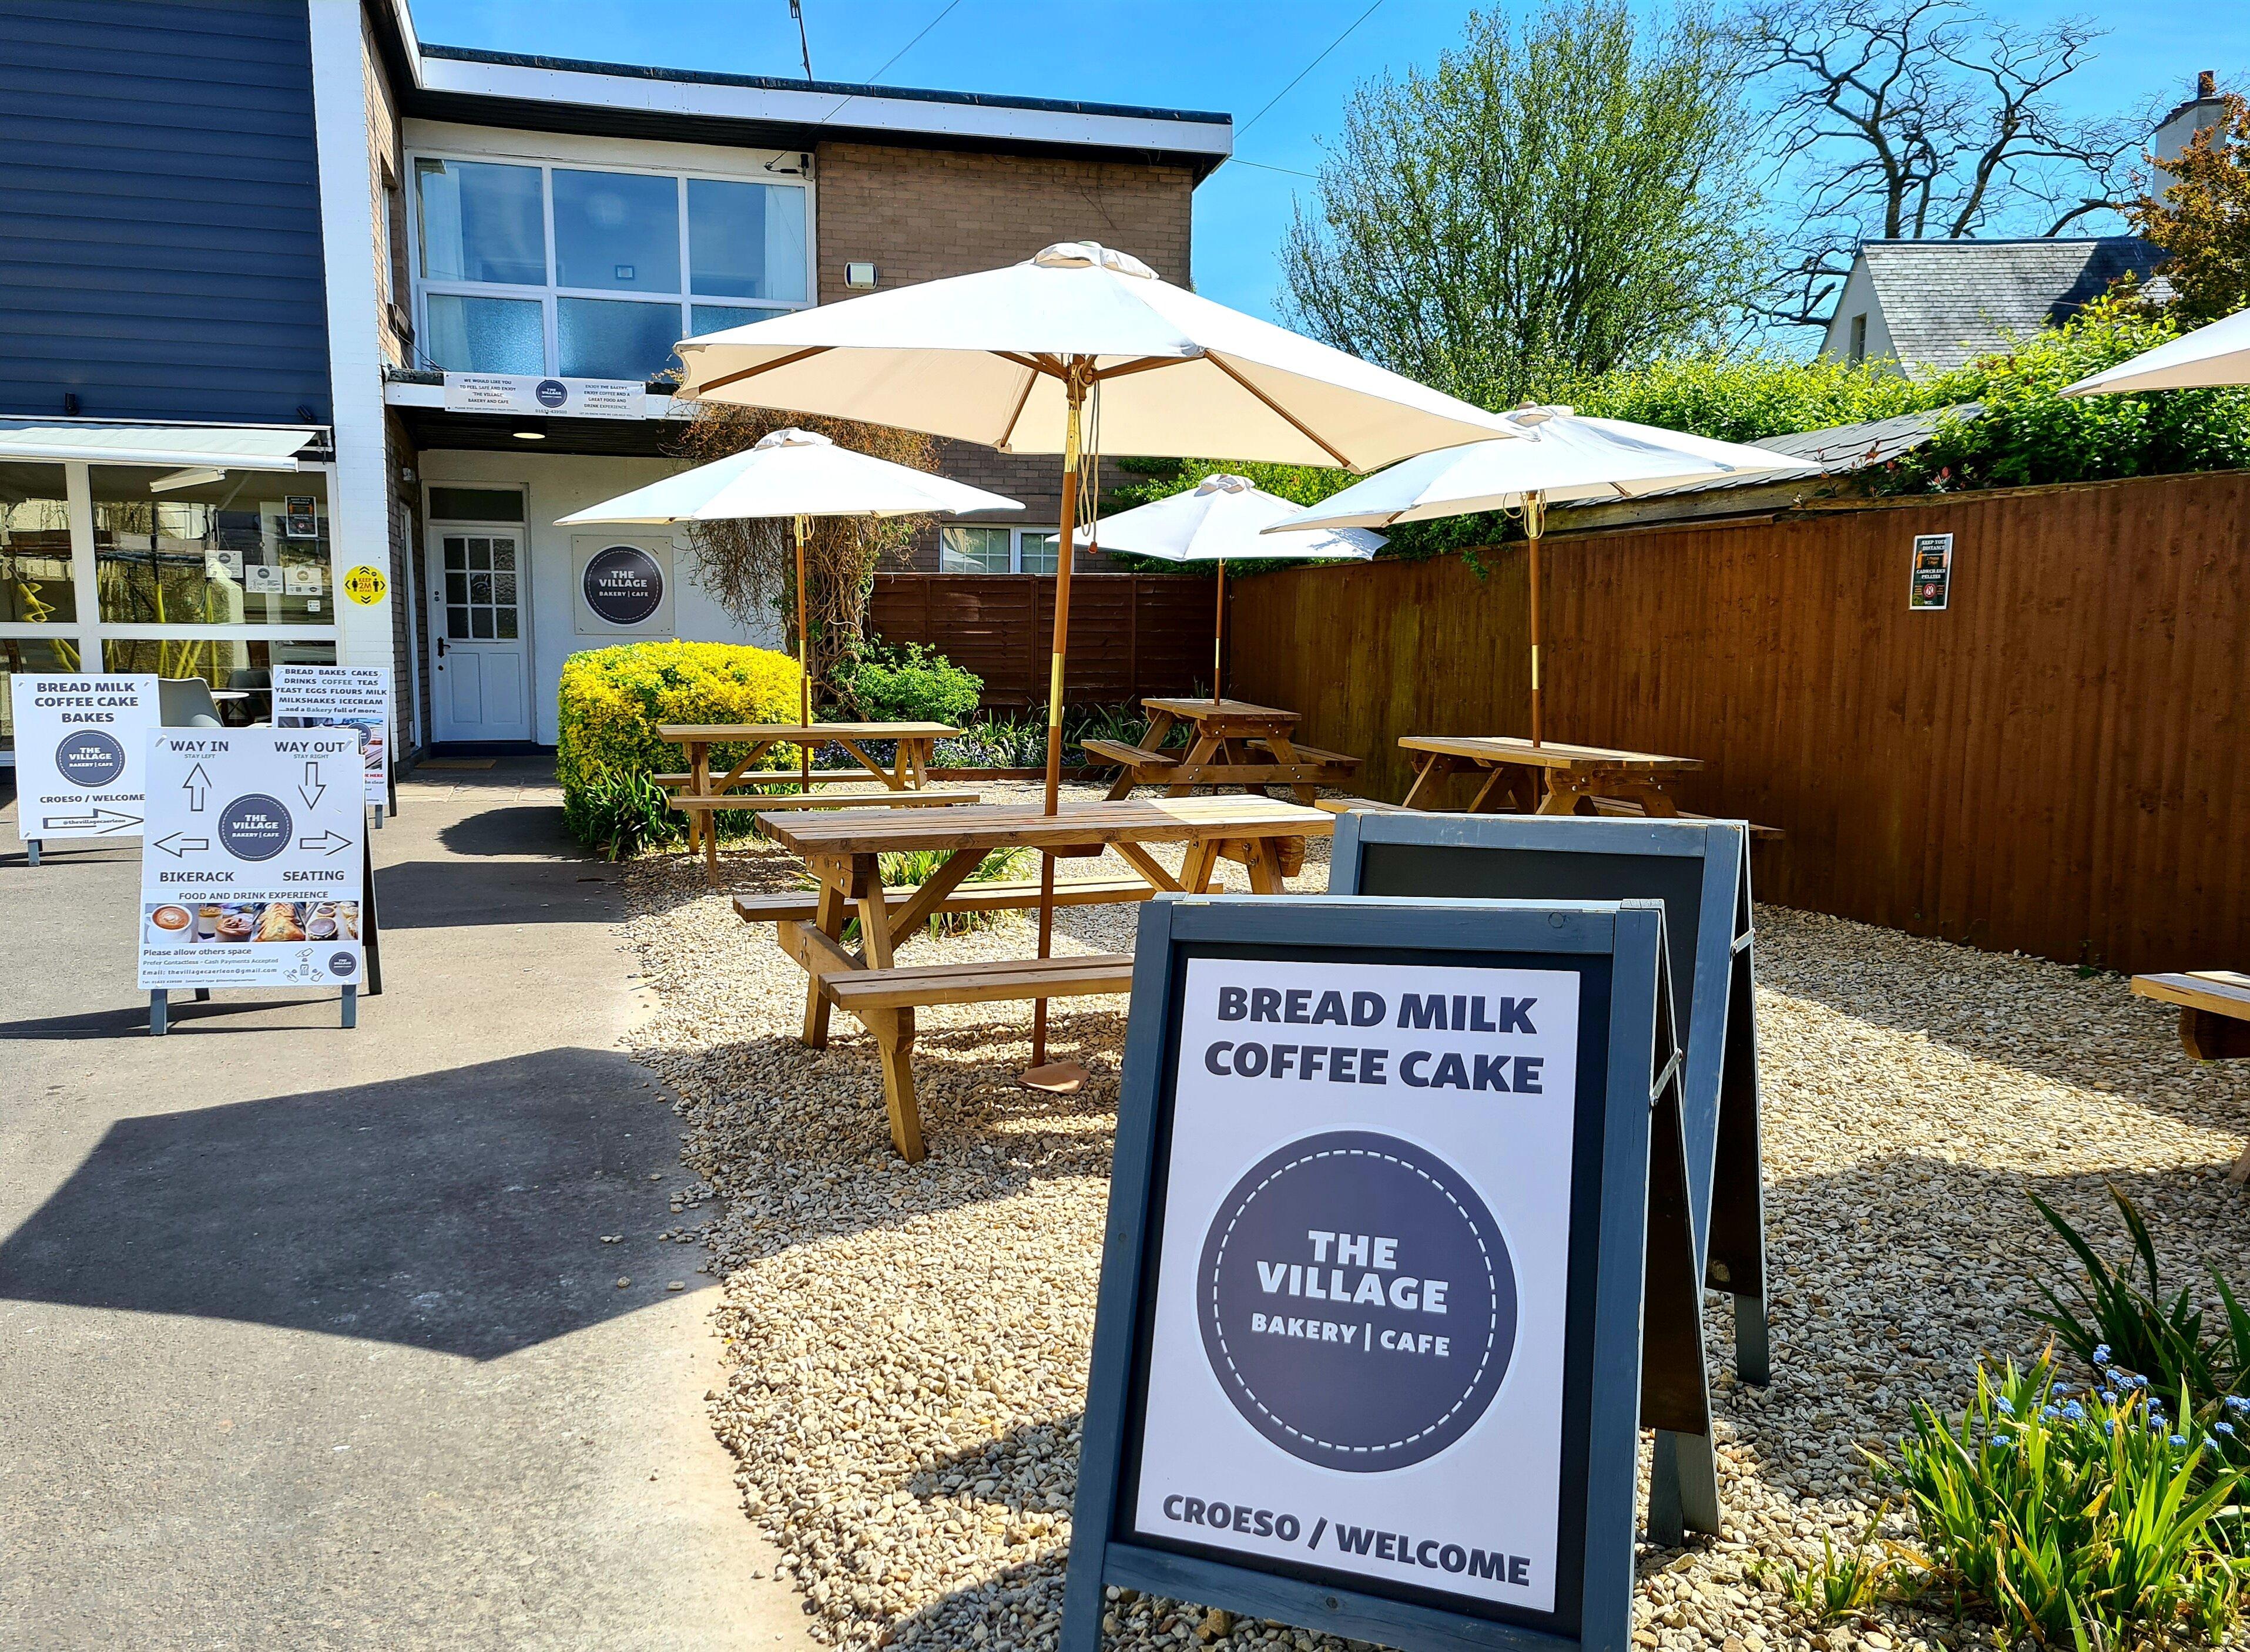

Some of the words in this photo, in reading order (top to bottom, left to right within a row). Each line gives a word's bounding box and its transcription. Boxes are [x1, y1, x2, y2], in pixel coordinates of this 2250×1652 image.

[611, 570, 635, 579] THE
[37, 683, 91, 692] BREAD
[95, 683, 135, 692] MILK
[35, 697, 94, 707] COFFEE
[97, 697, 139, 706] CAKE
[62, 713, 114, 723] BAKES
[170, 741, 206, 751] WAY
[210, 741, 229, 751] IN
[274, 742, 310, 752] WAY
[314, 742, 345, 753] OUT
[160, 872, 234, 882] BIKERACK
[283, 871, 344, 881] SEATING
[1218, 986, 1386, 1028] BREAD
[1397, 992, 1538, 1035] MILK
[1204, 1040, 1389, 1085] COFFEE
[1399, 1050, 1545, 1094] CAKE
[1307, 1230, 1399, 1270] THE
[1256, 1260, 1448, 1314] VILLAGE
[1251, 1312, 1357, 1344] BAKERY
[1380, 1329, 1450, 1356] CAFE
[1162, 1493, 1301, 1542] CROESO
[1334, 1523, 1531, 1587] WELCOME
